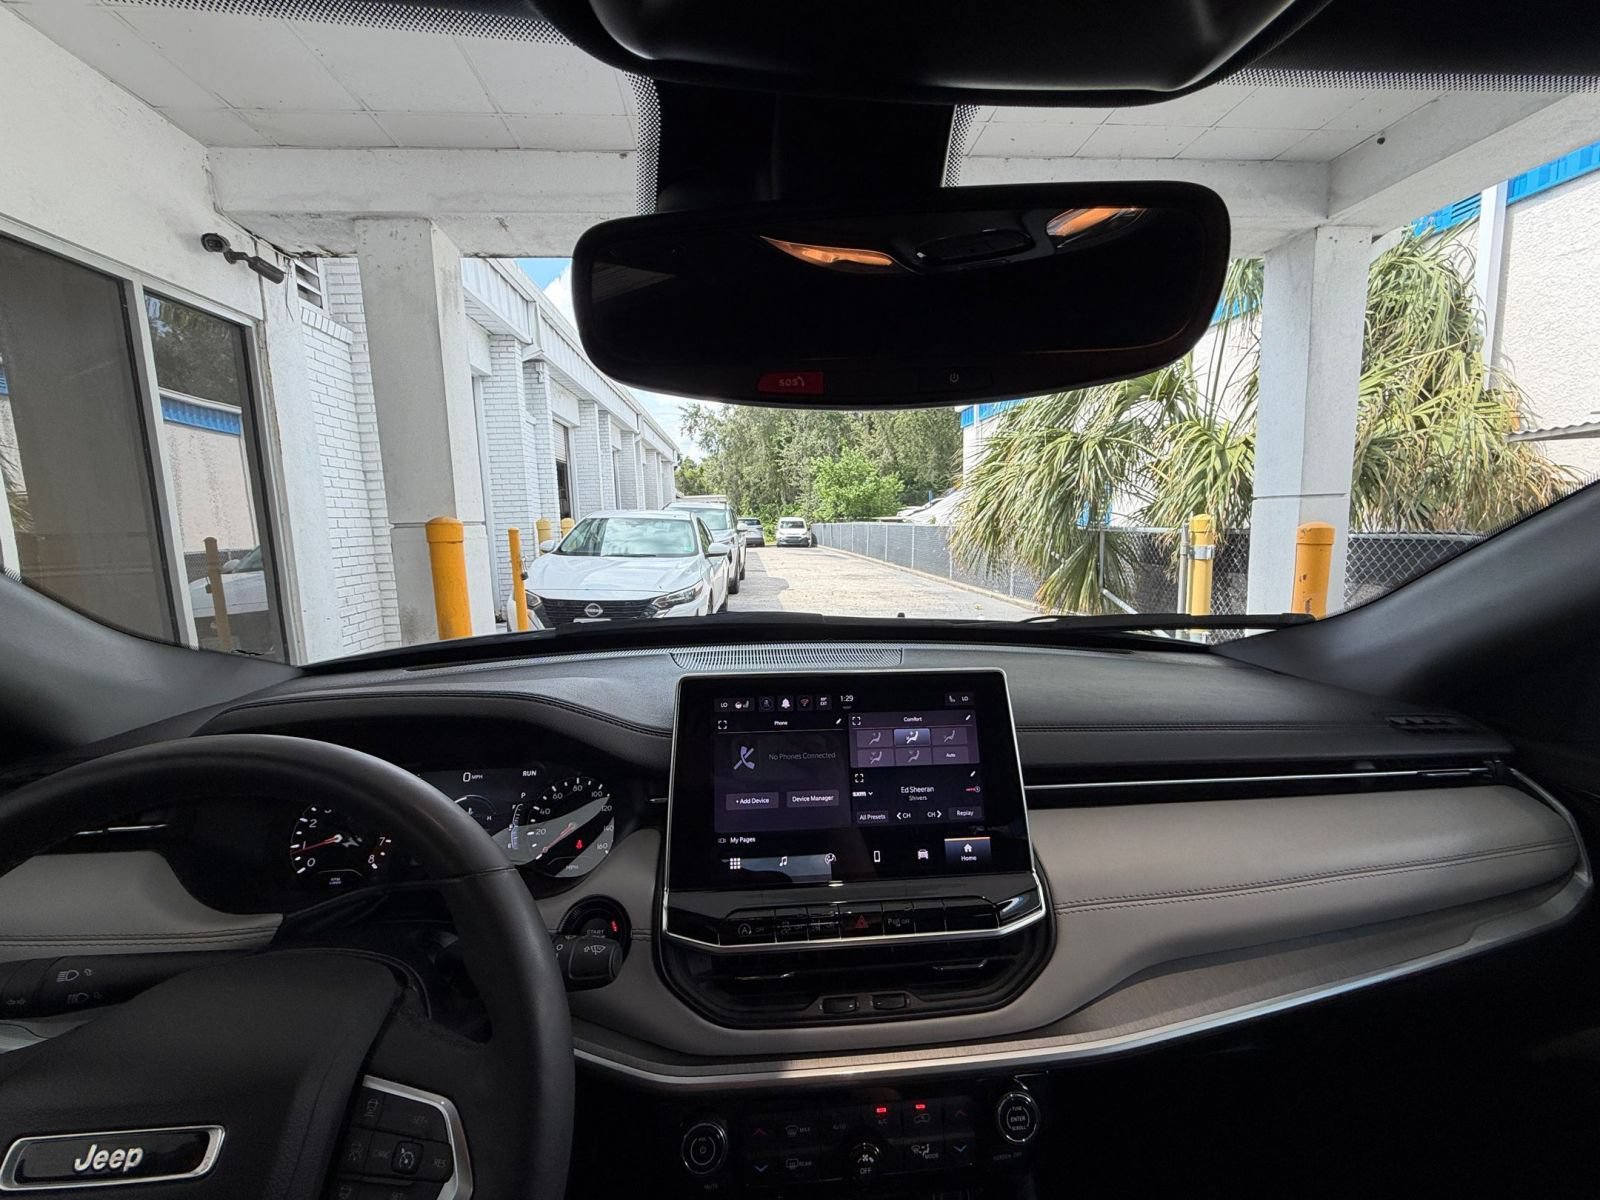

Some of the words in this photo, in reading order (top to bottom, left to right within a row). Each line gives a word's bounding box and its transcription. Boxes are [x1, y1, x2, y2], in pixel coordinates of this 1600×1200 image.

[778, 378, 798, 387] SOS
[840, 694, 854, 702] 1:29
[769, 753, 778, 761] No
[803, 752, 836, 760] Connected
[463, 772, 471, 783] 0
[810, 795, 834, 803] Manager
[309, 818, 318, 828] 2
[536, 828, 547, 836] 20
[379, 836, 386, 846] 7
[740, 836, 756, 844] Pages
[368, 854, 375, 864] 8
[74, 1143, 143, 1173] Jeep
[859, 1167, 872, 1175] OFF
